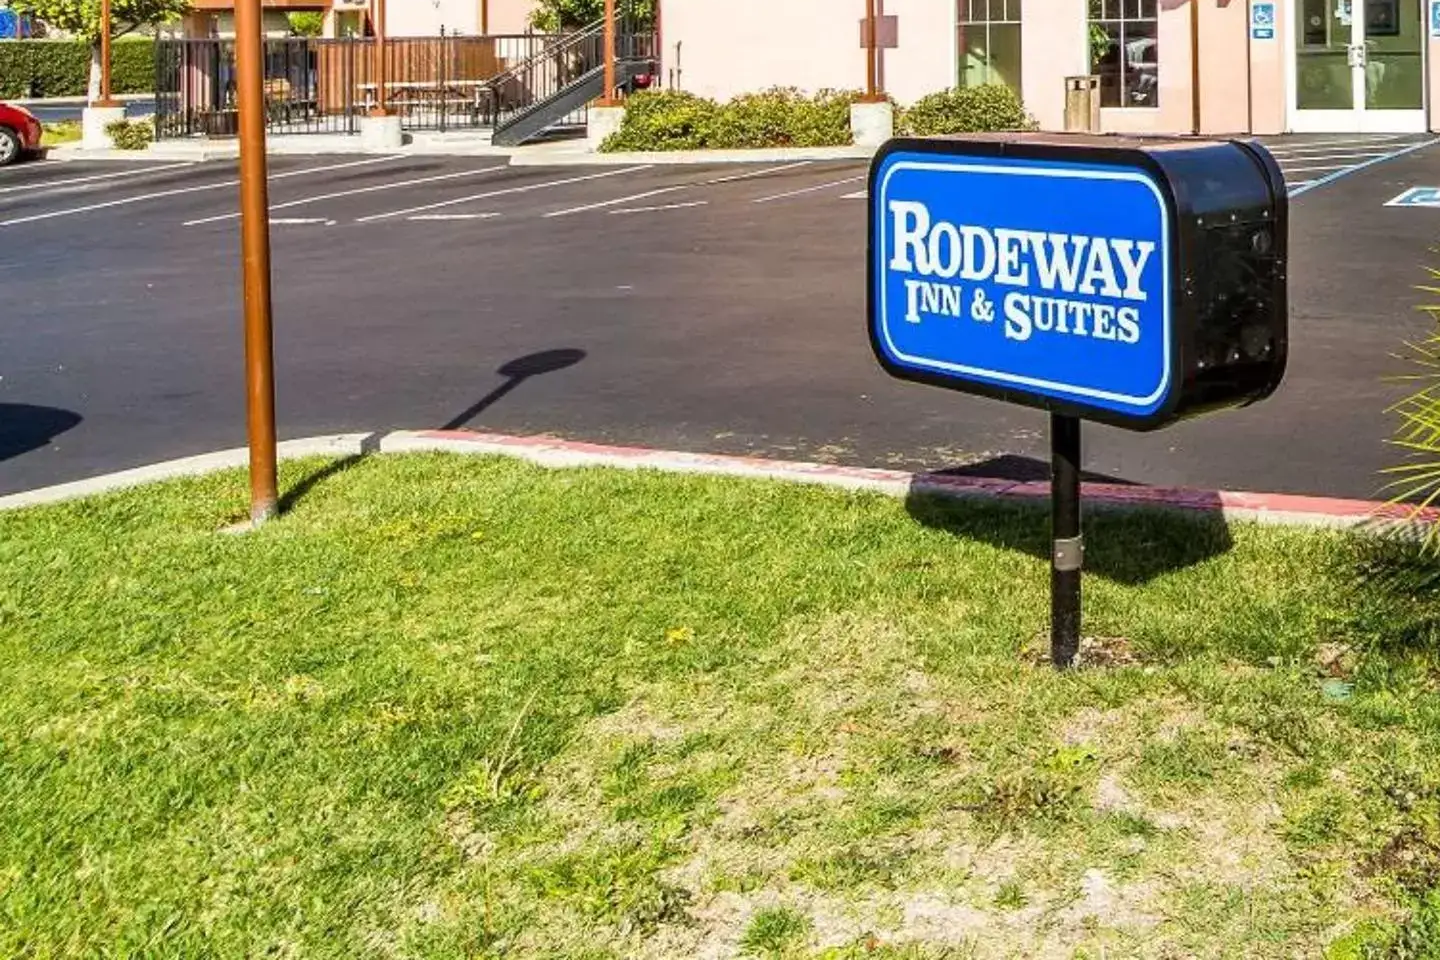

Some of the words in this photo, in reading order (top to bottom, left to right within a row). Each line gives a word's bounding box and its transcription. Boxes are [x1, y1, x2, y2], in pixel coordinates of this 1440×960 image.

[888, 200, 1155, 301] RODEWAY
[904, 279, 962, 324] INN
[971, 287, 995, 323] &
[1004, 292, 1141, 344] SUITES
